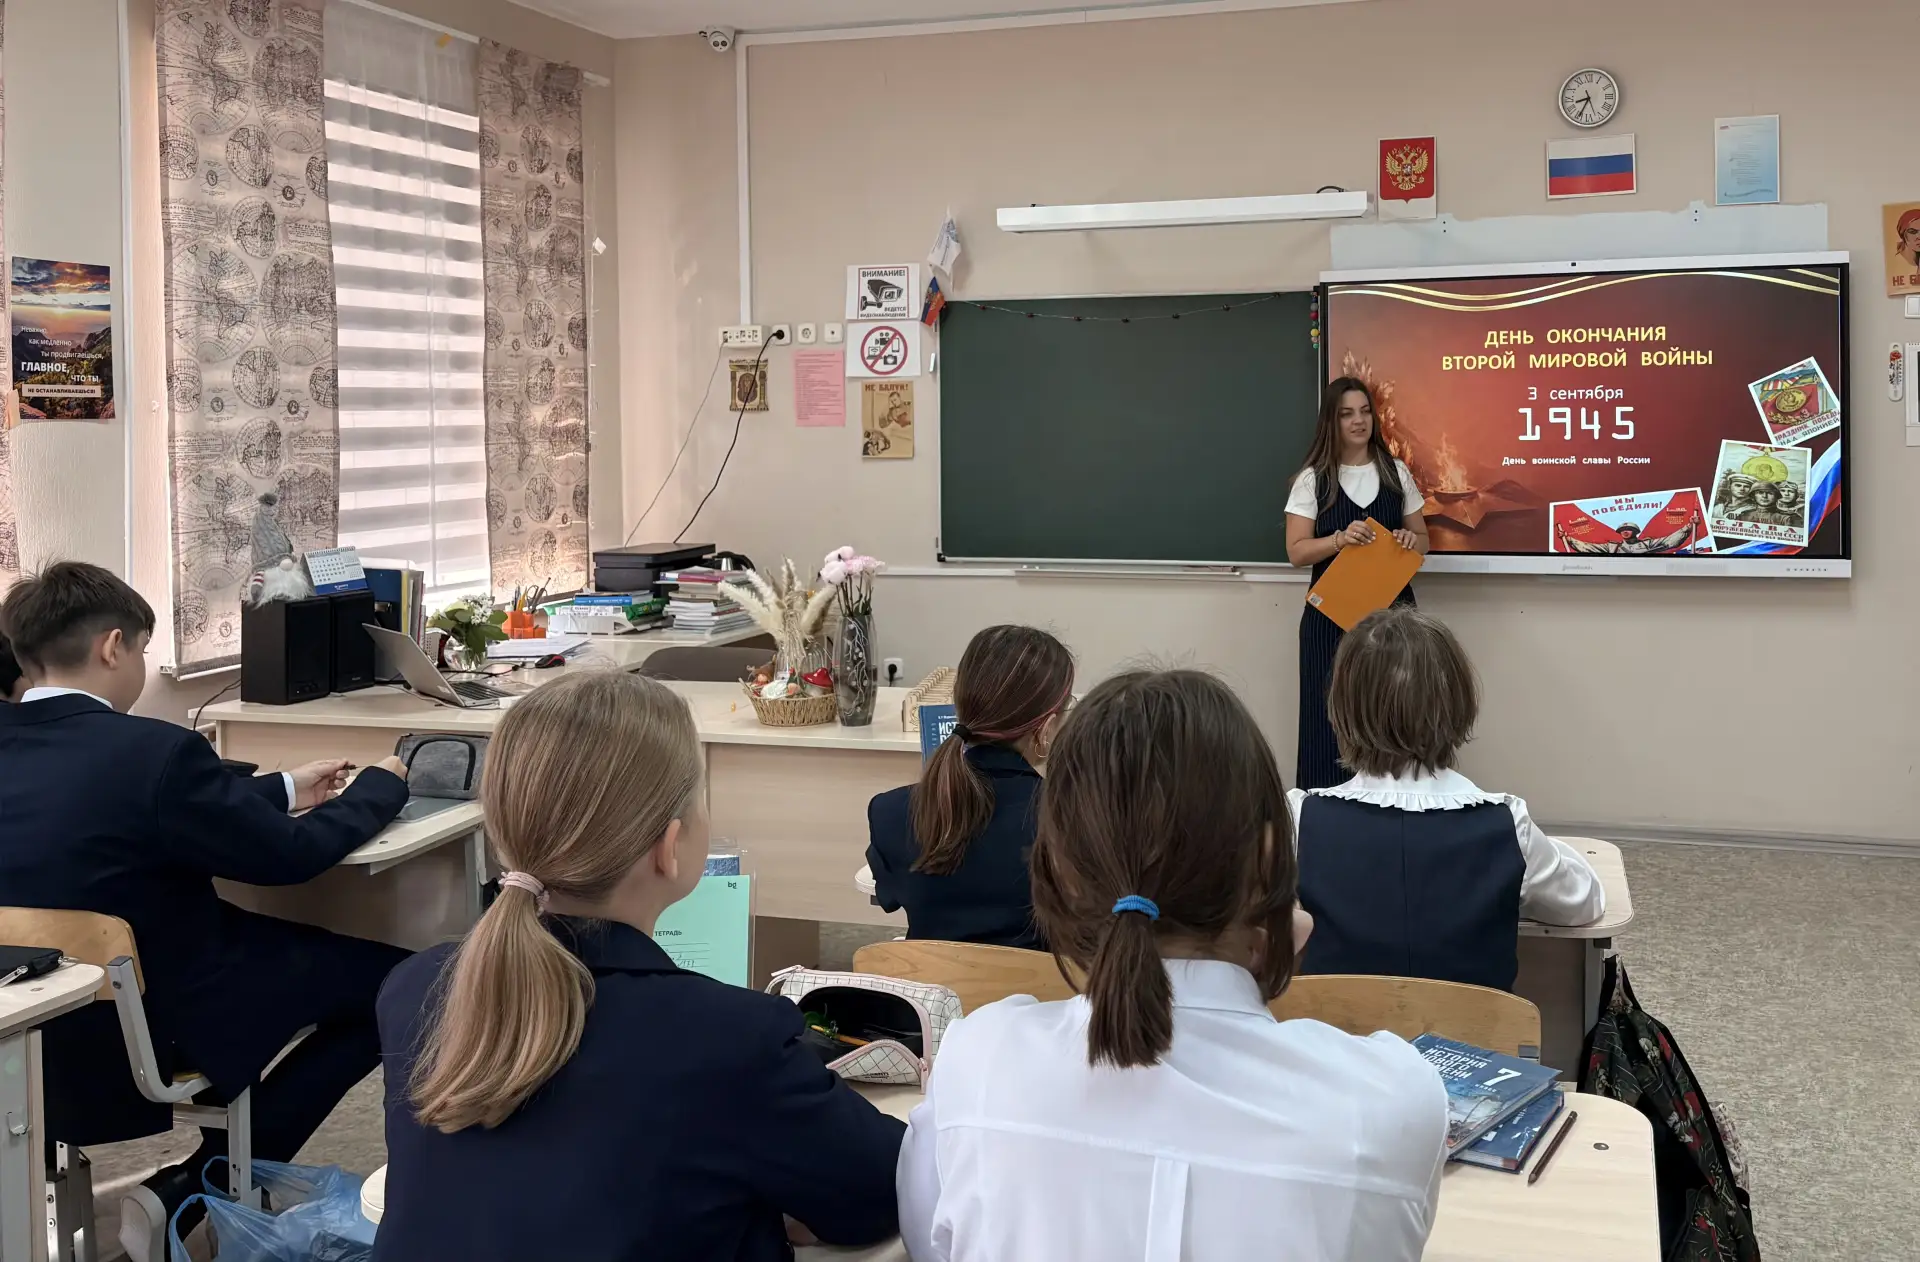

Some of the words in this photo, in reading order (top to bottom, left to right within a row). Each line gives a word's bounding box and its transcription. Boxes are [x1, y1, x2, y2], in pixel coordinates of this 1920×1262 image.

[1892, 275, 1905, 286] НЕ
[1485, 330, 1534, 348] ДЕНЬ
[1546, 326, 1666, 344] ОКОНЧАНИЯ
[21, 361, 70, 374] ГЛАВНОЕ,
[1442, 351, 1516, 370] ВТОРОЙ
[1529, 349, 1627, 369] МИРОВОЙ
[1641, 347, 1713, 366] ВОЙНЫ
[1528, 386, 1538, 400] 3
[1549, 384, 1624, 402] сентября
[1518, 406, 1635, 441] 1945
[1801, 417, 1840, 437] ЯПОНИЕЙ
[1502, 455, 1527, 466] День
[1532, 454, 1577, 465] воинской
[1582, 456, 1612, 465] славы
[1617, 455, 1651, 464] России
[1591, 501, 1663, 516] ПОБЕДИЛИ!
[1715, 519, 1797, 533] СЛАВА
[1424, 1047, 1488, 1069] ИСТОРИЯ
[1482, 1067, 1522, 1087] 7
